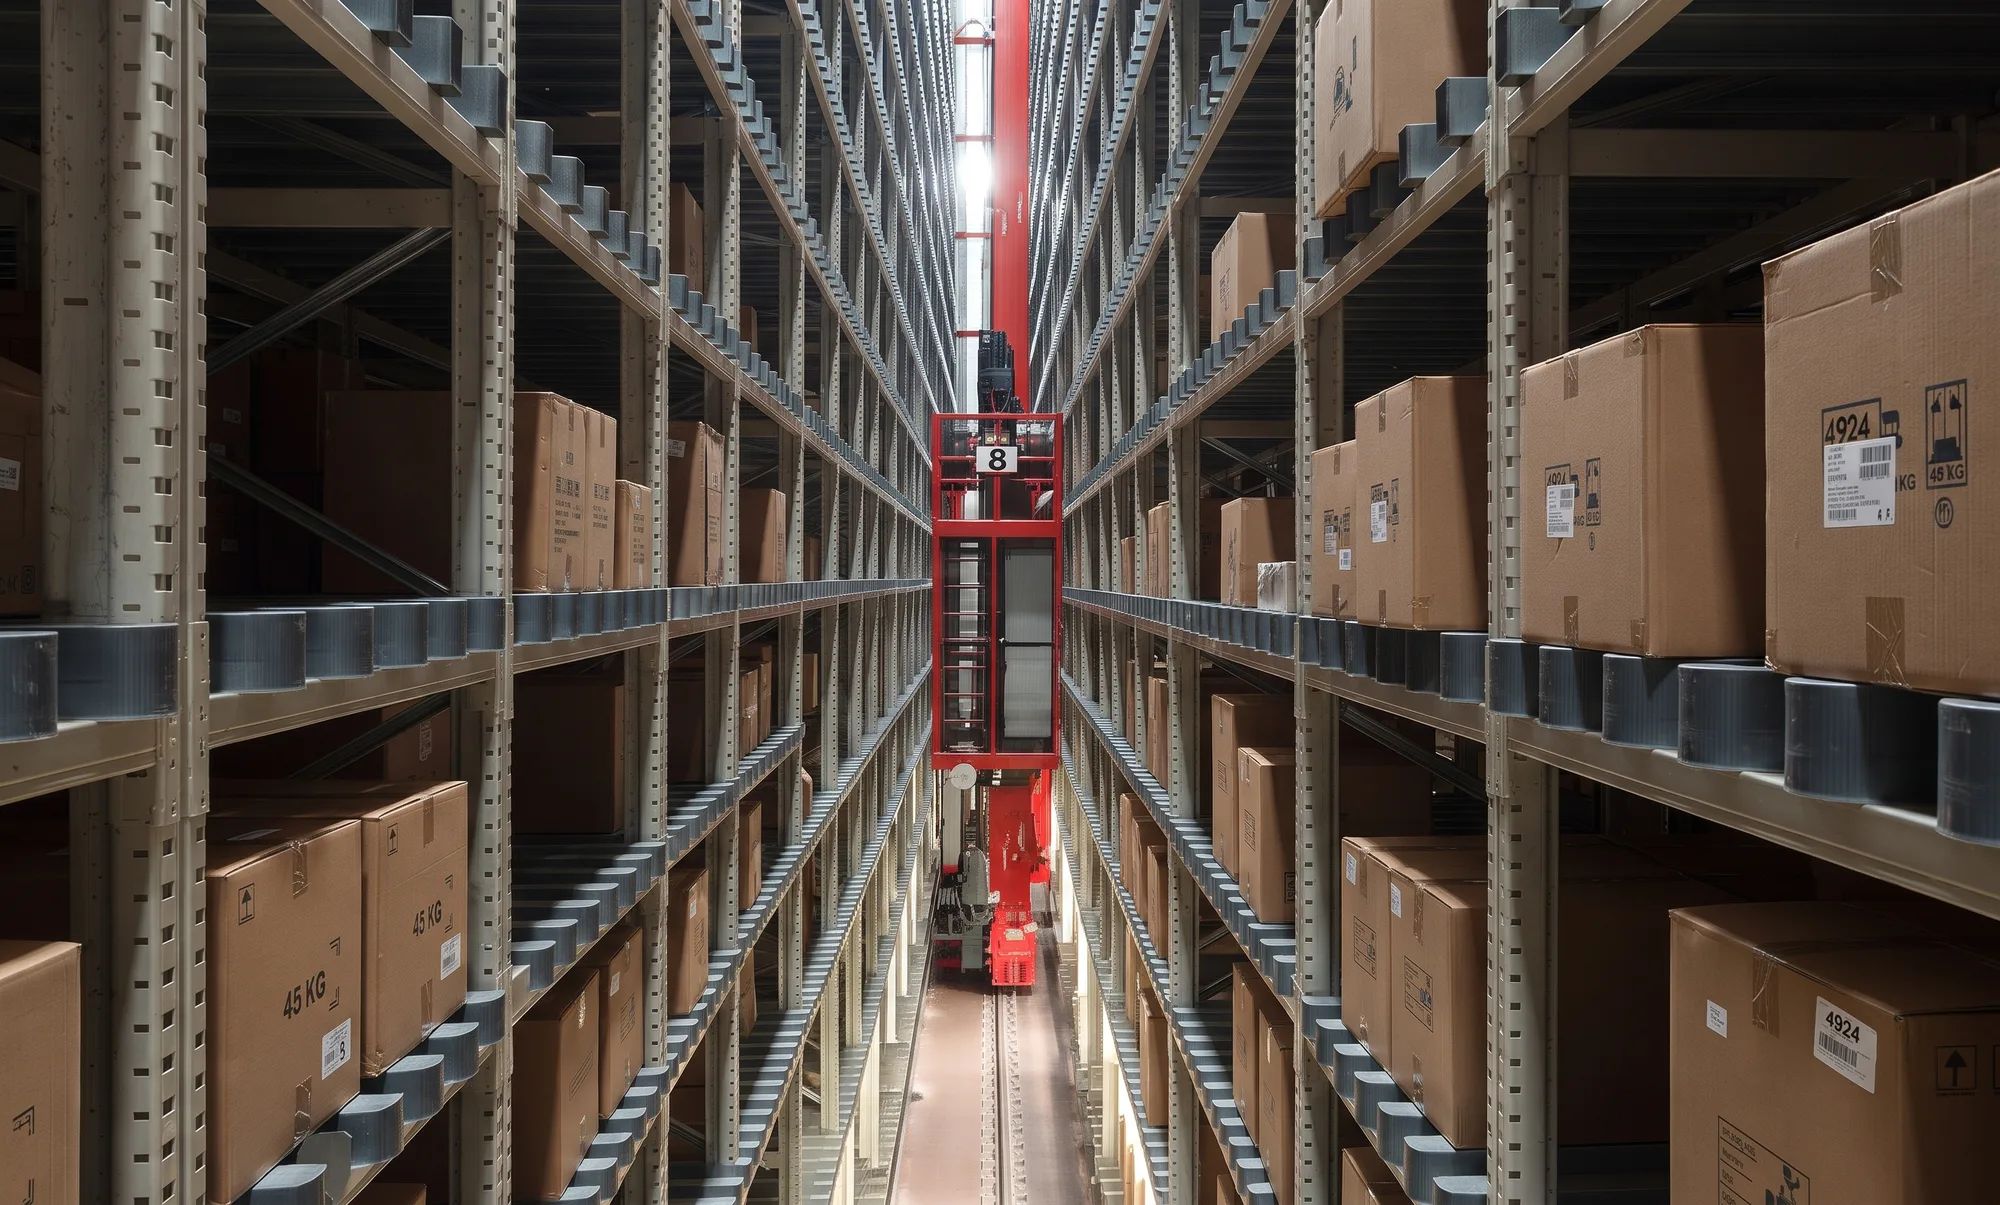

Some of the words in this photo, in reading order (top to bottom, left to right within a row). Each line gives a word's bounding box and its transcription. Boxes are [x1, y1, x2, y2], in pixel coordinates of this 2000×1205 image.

[1825, 411, 1870, 445] 4924
[988, 448, 1007, 471] 8
[1947, 464, 1964, 480] KG
[1895, 474, 1916, 493] KG
[412, 910, 425, 936] 45
[428, 899, 442, 930] KG
[283, 985, 302, 1019] 45
[306, 970, 326, 1008] KG
[1825, 1010, 1860, 1044] 4924
